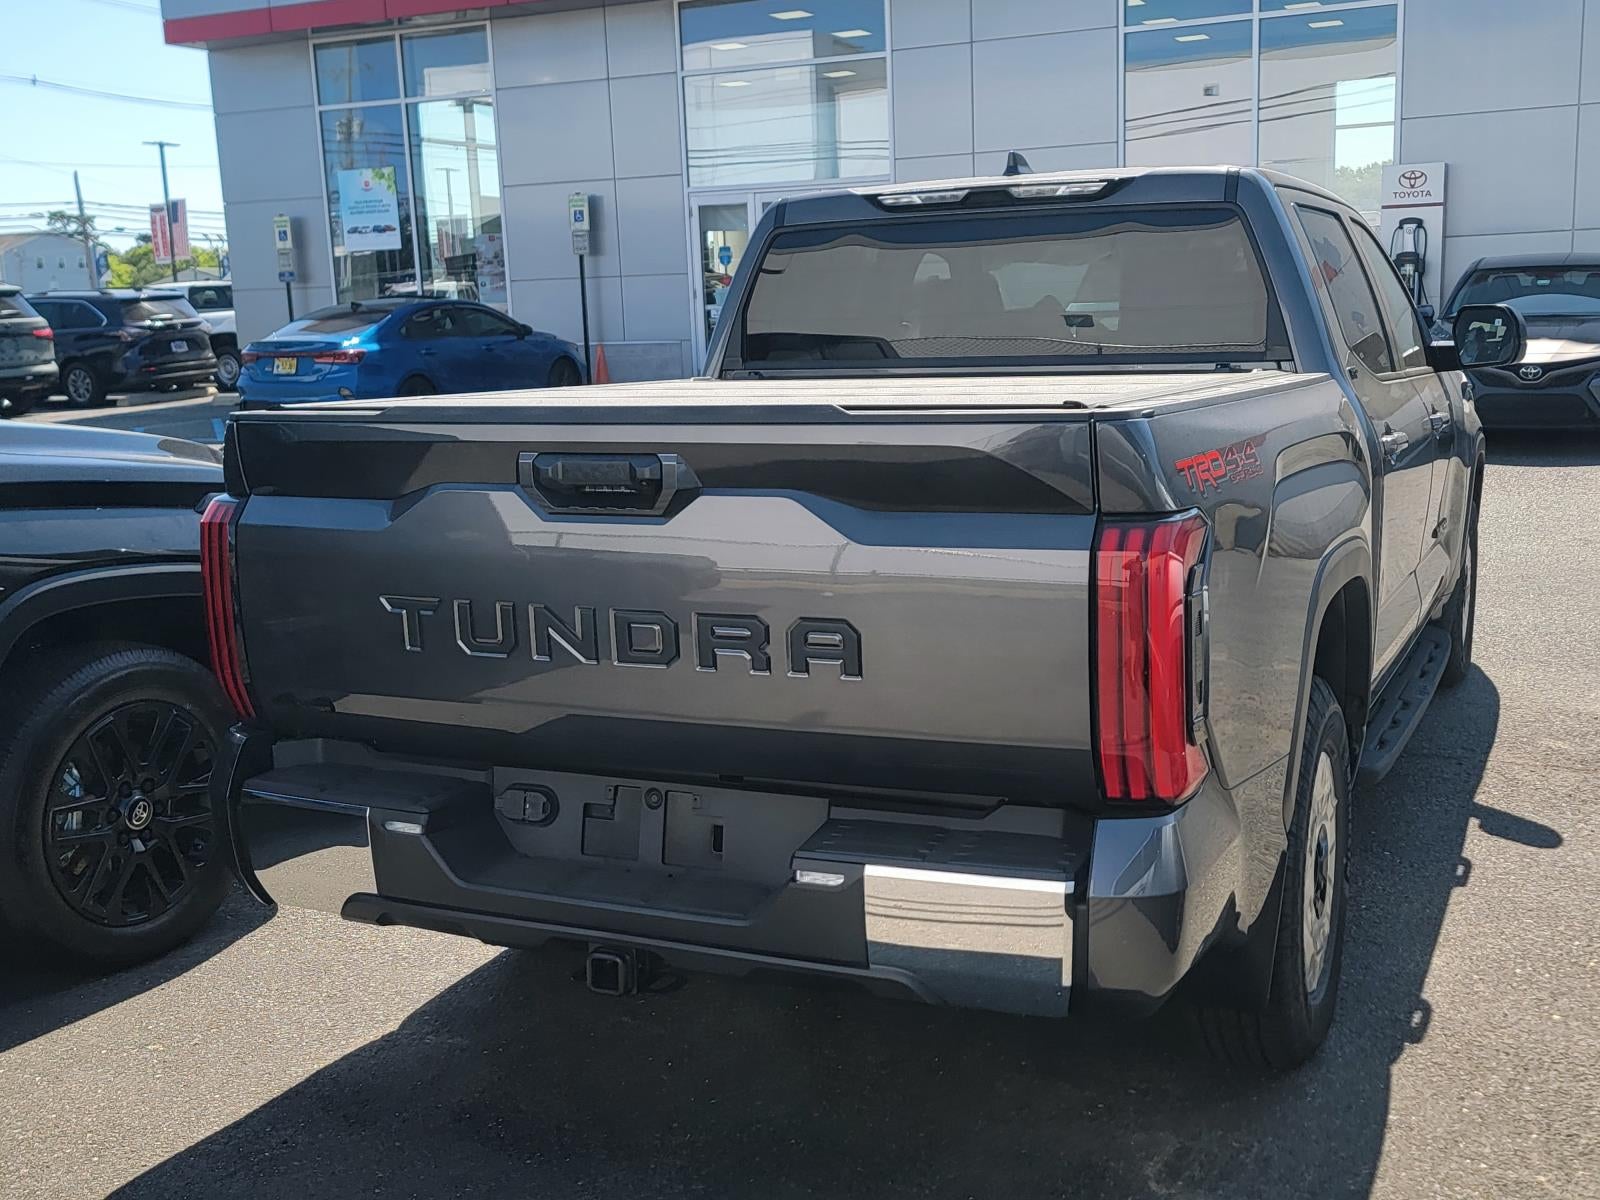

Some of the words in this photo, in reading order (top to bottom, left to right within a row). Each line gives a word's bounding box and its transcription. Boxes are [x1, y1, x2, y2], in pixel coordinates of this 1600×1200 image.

[1392, 190, 1432, 199] TOYOTA
[1174, 449, 1225, 493] TRD
[379, 595, 864, 681] TUNDRA
